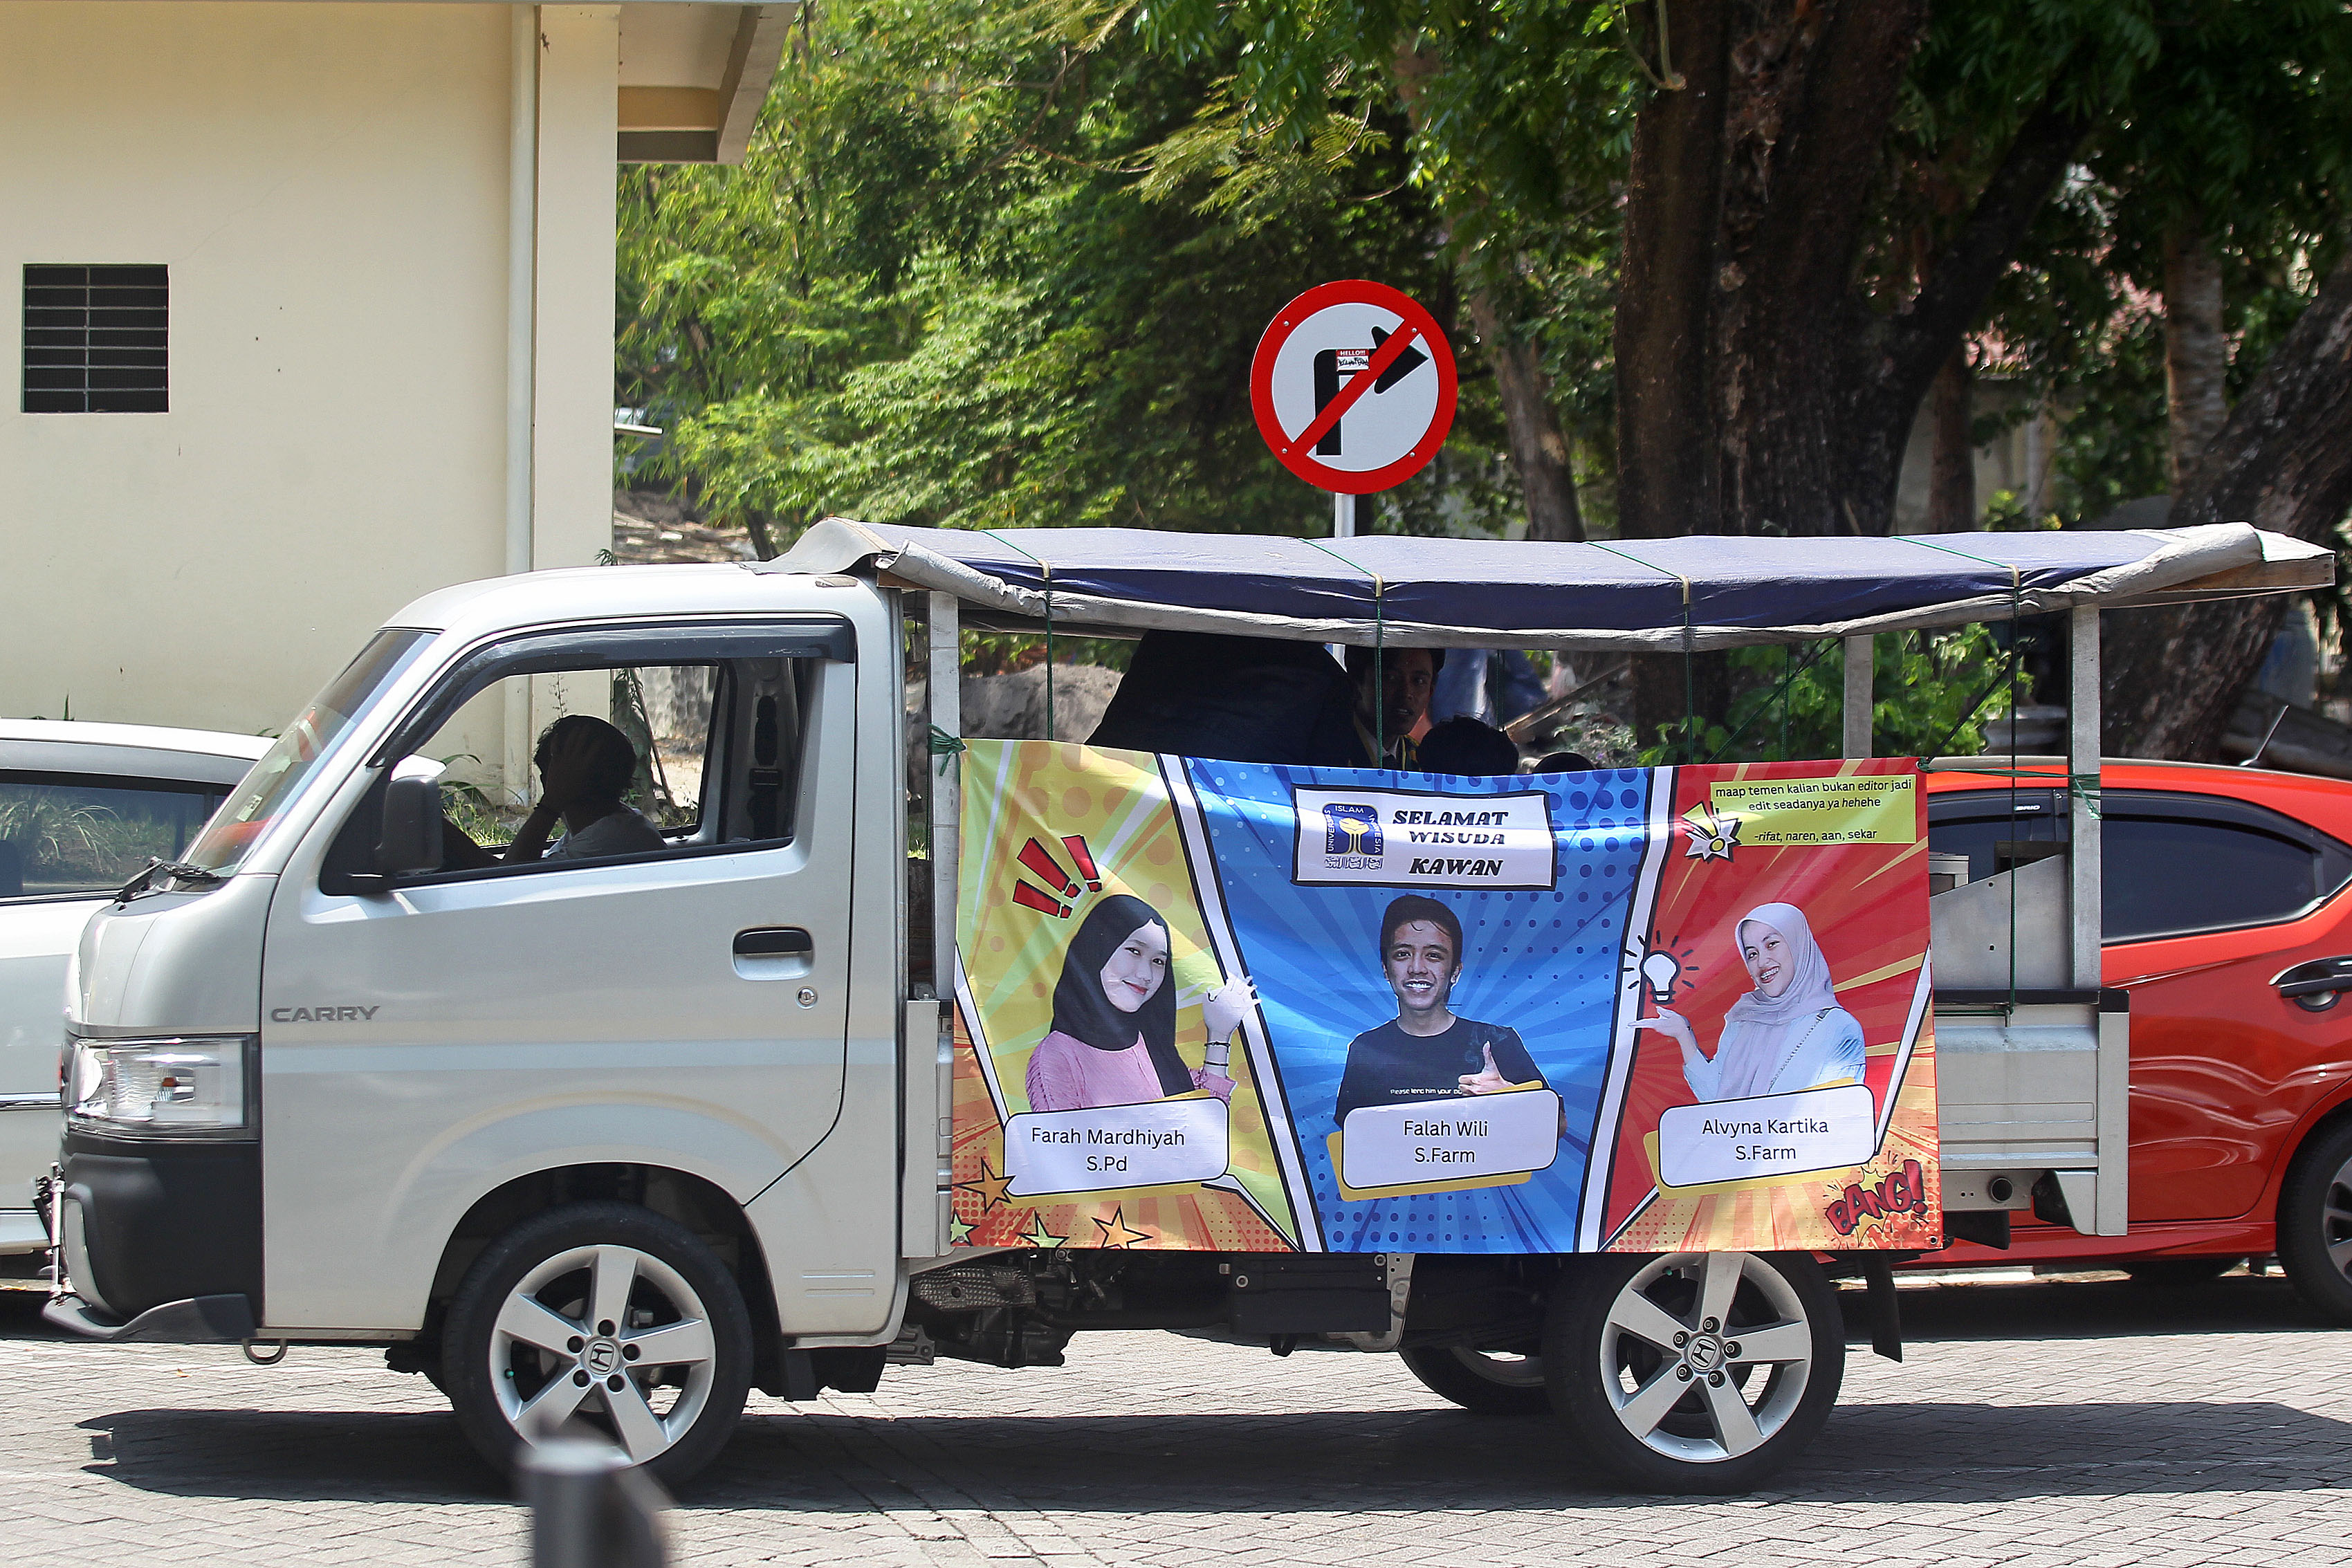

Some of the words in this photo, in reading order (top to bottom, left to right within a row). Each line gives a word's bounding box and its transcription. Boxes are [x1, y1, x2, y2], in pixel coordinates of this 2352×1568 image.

[1716, 788, 1746, 798] maap
[1749, 786, 1784, 795] temen
[1787, 784, 1819, 793] kalian
[1822, 782, 1855, 791] bukan
[1858, 781, 1889, 791] editor
[1891, 780, 1911, 792] jadi
[1335, 805, 1364, 813] ISLAM
[1749, 802, 1771, 810] edit
[1774, 799, 1825, 811] seadanya
[1827, 800, 1839, 811] ya
[1841, 797, 1881, 807] hehehe
[1393, 810, 1509, 826] SELAMAT
[1409, 831, 1505, 845] WISUDA
[1754, 831, 1783, 842] -rifat,
[1785, 832, 1819, 842] naren,
[1821, 832, 1845, 841] aan,
[1848, 829, 1877, 839] sekar
[1408, 858, 1504, 876] KAWAN
[272, 1006, 380, 1022] CARRY
[1404, 1120, 1451, 1136] Falah
[1456, 1120, 1489, 1137] Wili
[1702, 1119, 1763, 1138] Alvyna
[1767, 1118, 1830, 1134] Kartika
[1031, 1127, 1081, 1144] Farah
[1087, 1129, 1185, 1149] Mardhiyah
[1415, 1147, 1476, 1163] S.Farm
[1736, 1145, 1797, 1160] S.Farm
[1087, 1156, 1128, 1172] S.Pd
[1825, 1159, 1929, 1235] BANG!
